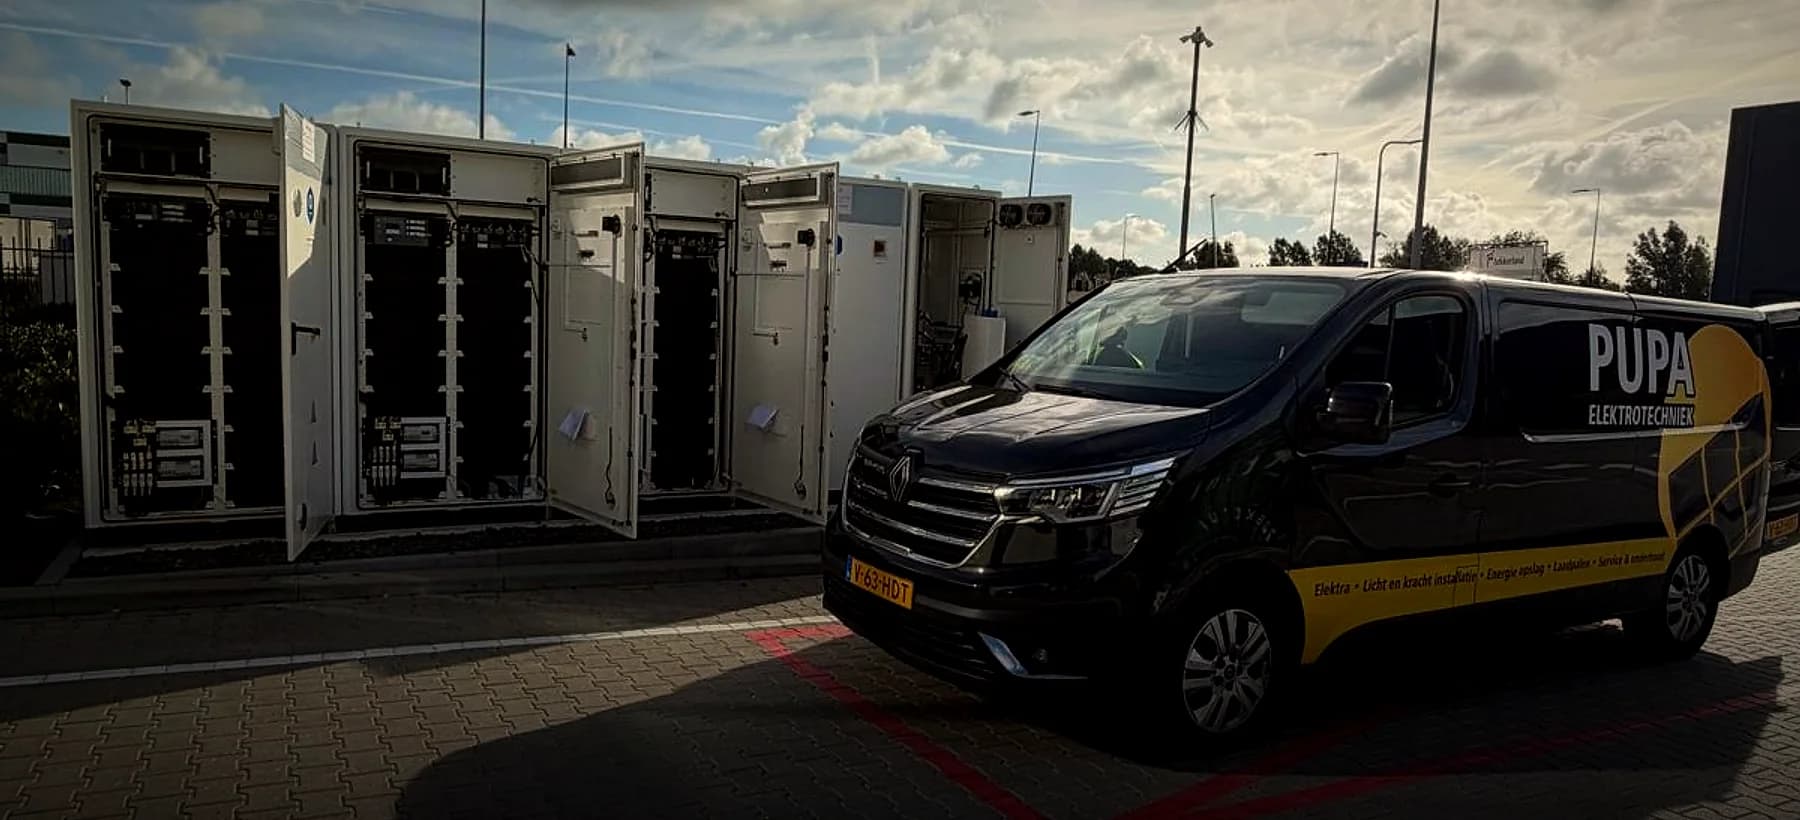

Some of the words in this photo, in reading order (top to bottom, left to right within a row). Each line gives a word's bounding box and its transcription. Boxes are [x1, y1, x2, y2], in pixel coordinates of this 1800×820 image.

[1588, 323, 1695, 395] PUPA
[1588, 404, 1694, 426] ELEKTROTECHNIEK
[1314, 580, 1350, 597] Elektra
[1363, 577, 1386, 592] Licht
[1389, 578, 1401, 590] en
[1402, 574, 1432, 589] kracht
